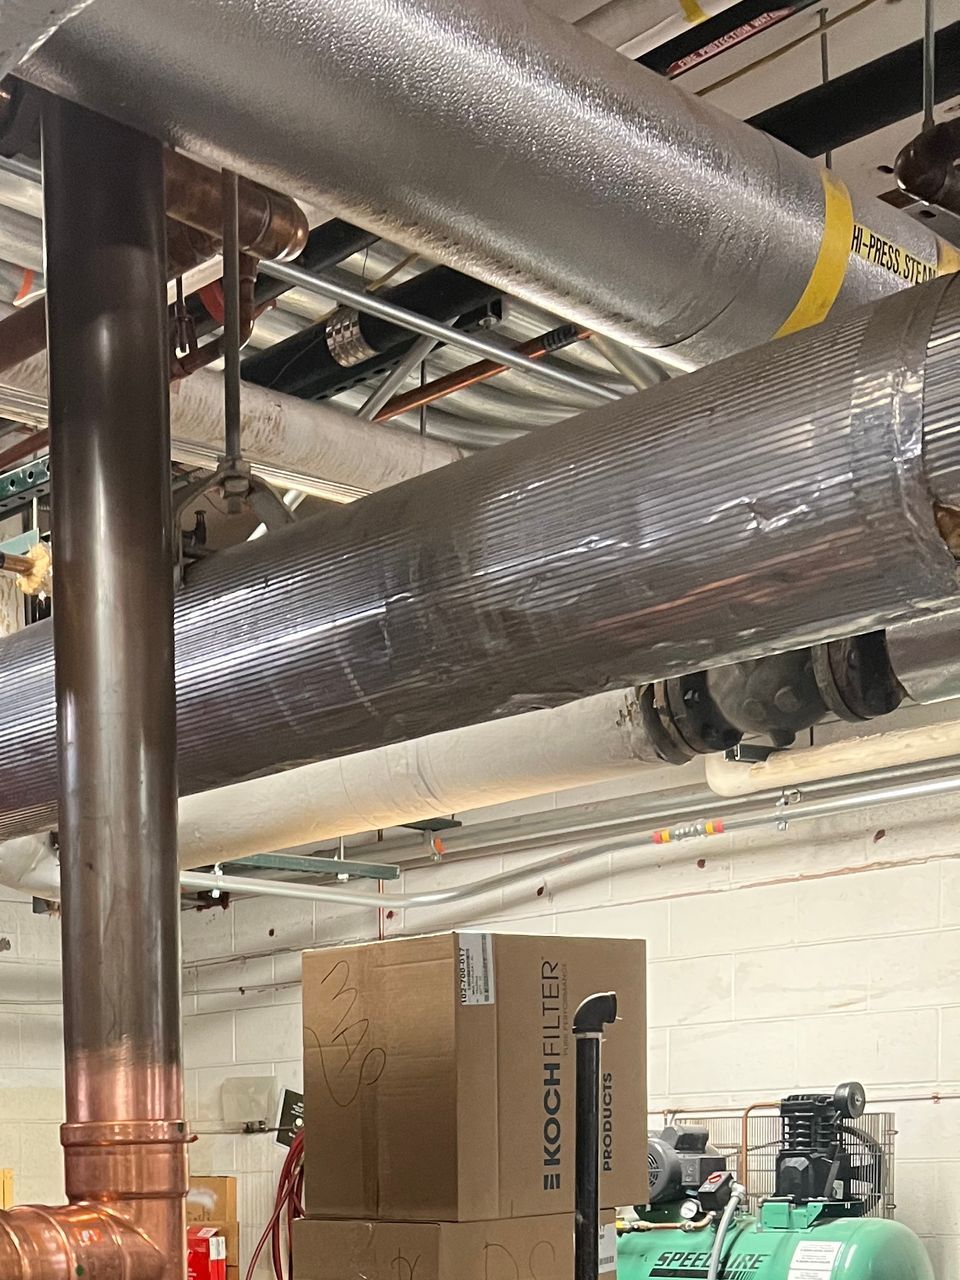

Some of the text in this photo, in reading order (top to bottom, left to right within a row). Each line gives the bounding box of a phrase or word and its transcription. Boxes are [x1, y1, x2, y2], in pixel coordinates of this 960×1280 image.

[850, 224, 902, 276] HI-PRESS.
[541, 960, 561, 1167] KOCHFILTER
[602, 1072, 613, 1172] PRODUCTS
